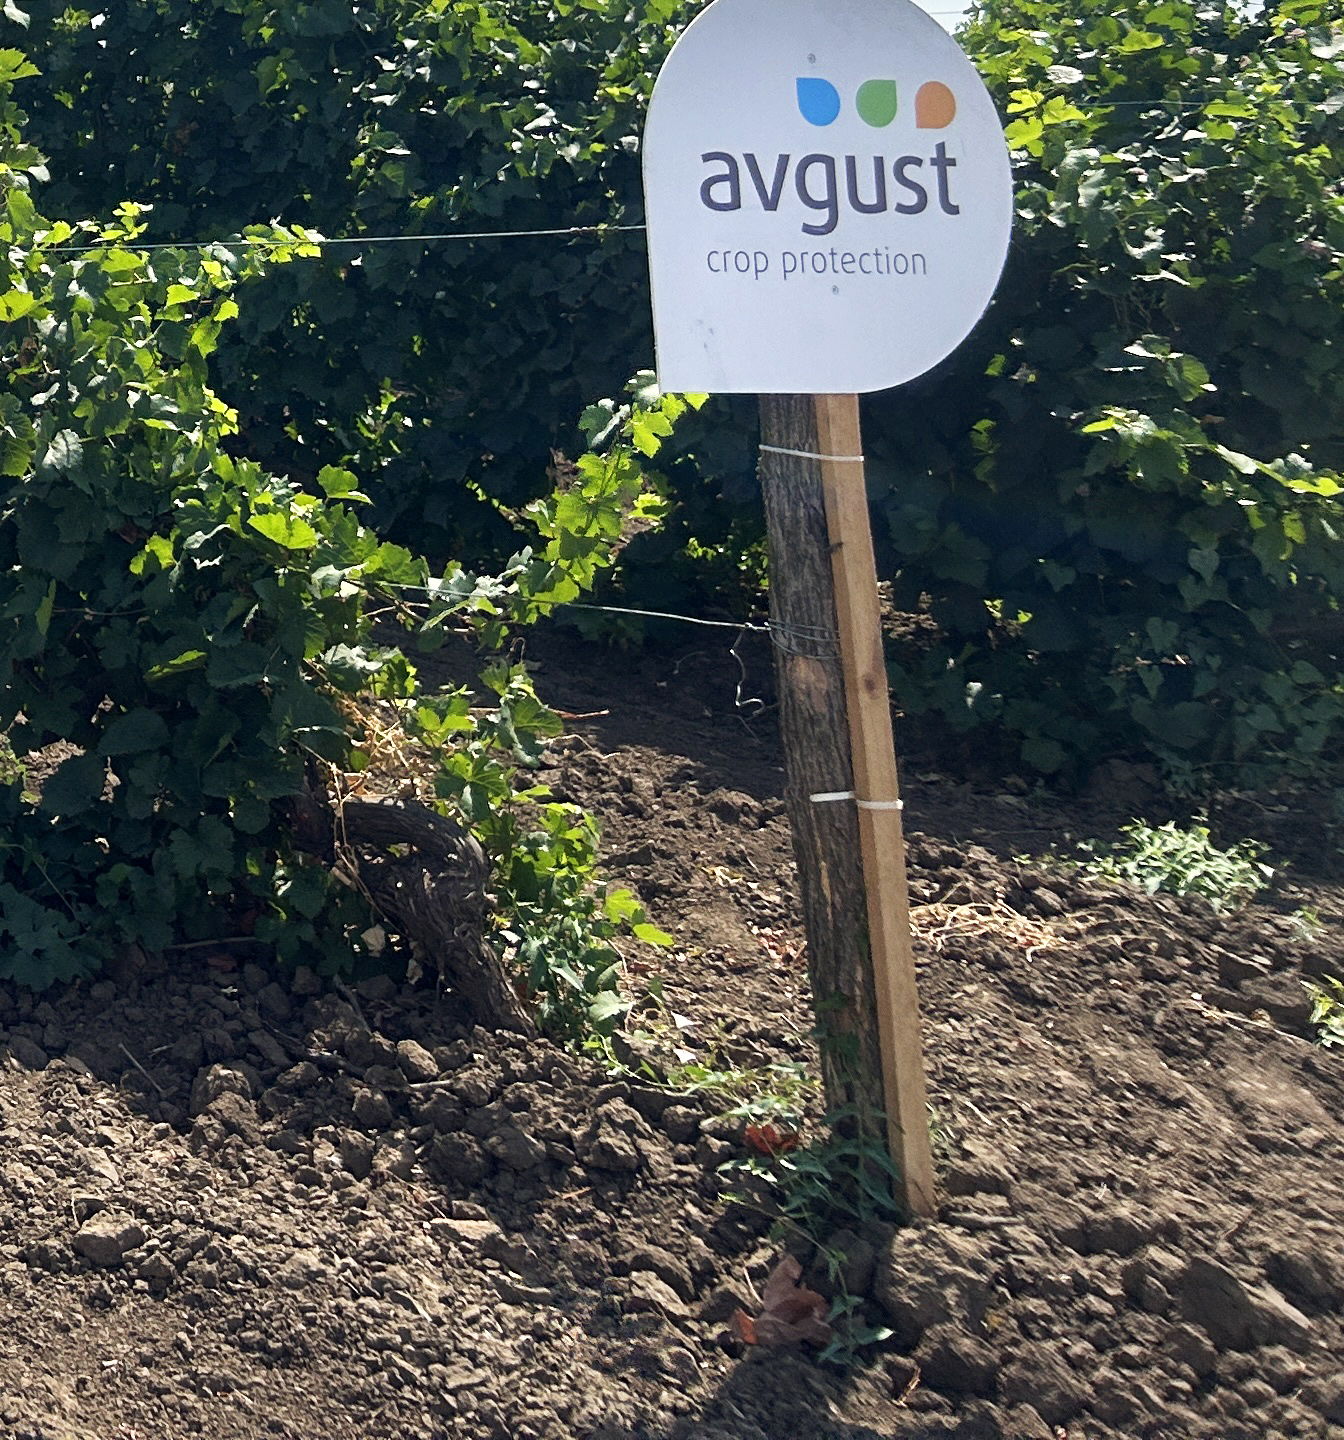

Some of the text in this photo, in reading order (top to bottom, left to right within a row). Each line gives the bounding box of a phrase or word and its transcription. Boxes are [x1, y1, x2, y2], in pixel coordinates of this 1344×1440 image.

[699, 141, 960, 236] avgust
[706, 246, 927, 281] crop protection
